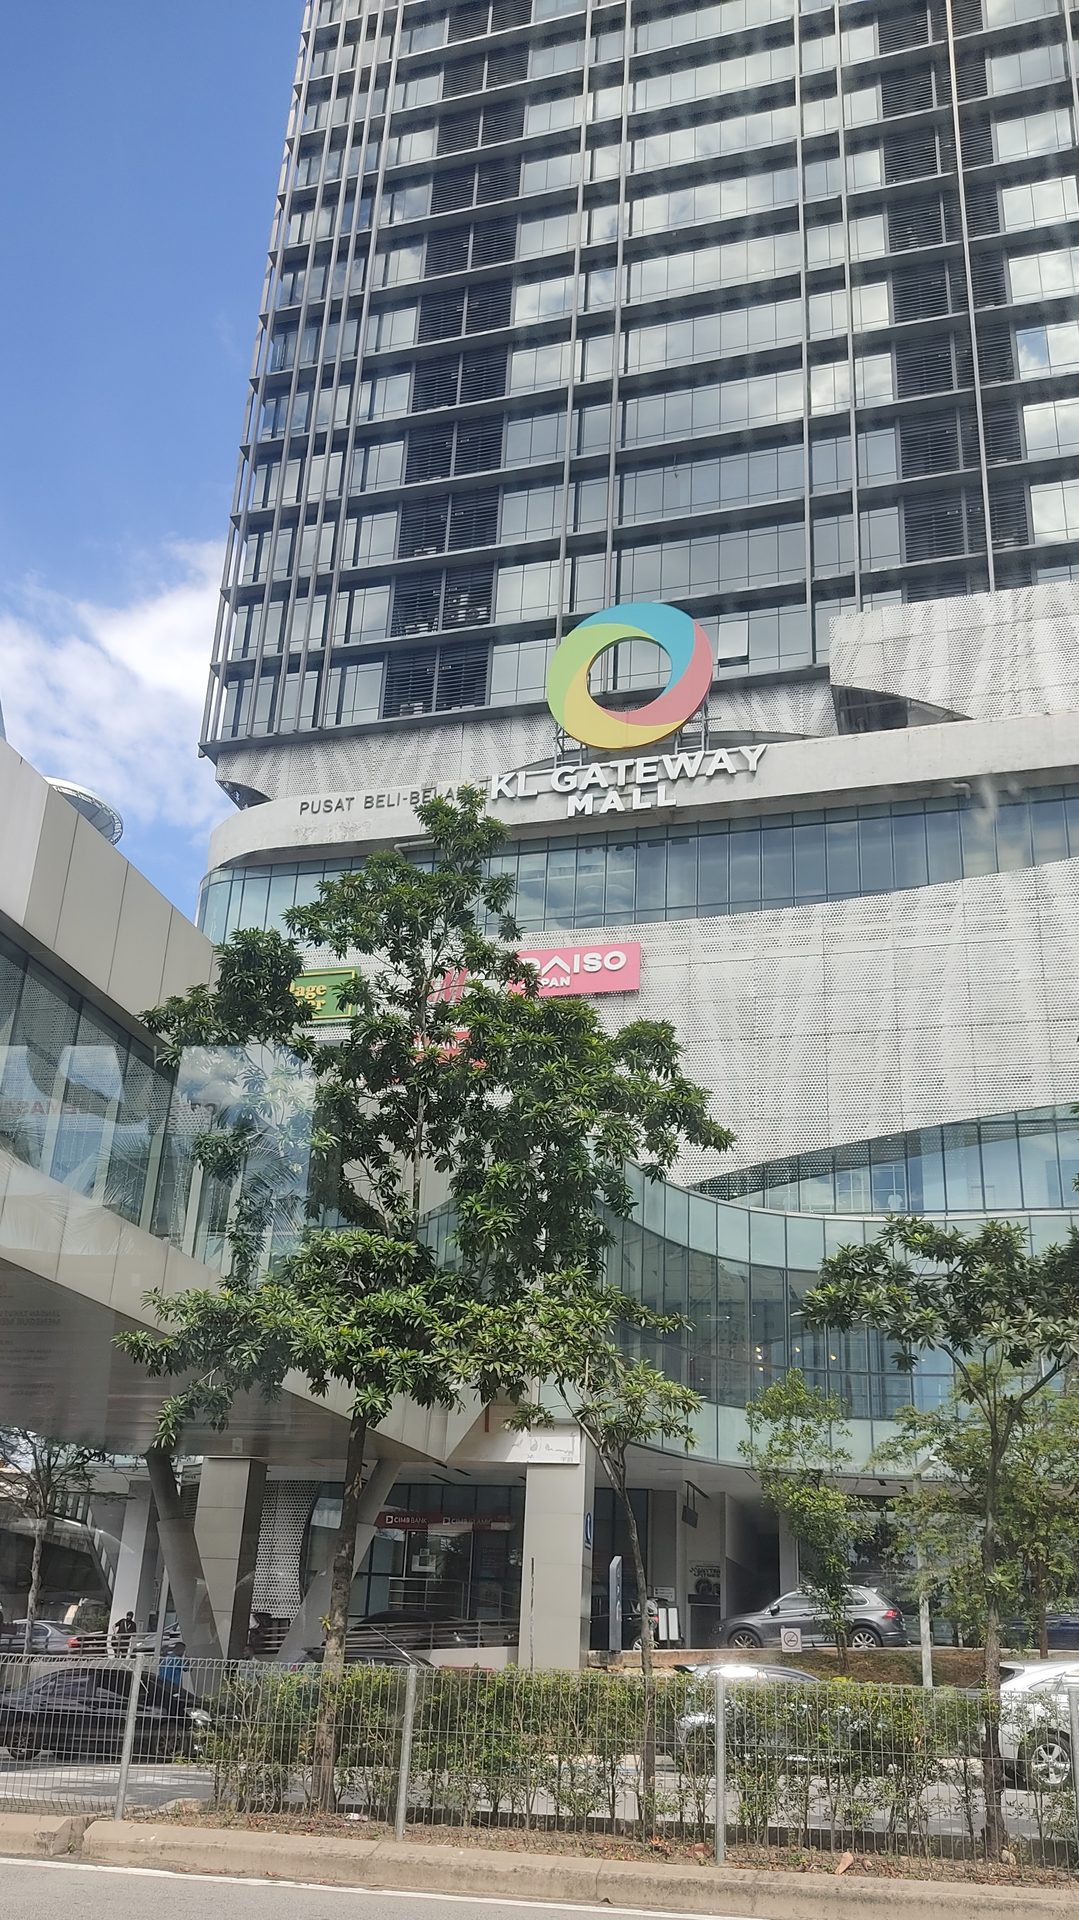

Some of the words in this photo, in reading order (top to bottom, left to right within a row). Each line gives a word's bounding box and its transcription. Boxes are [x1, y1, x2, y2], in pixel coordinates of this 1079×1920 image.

[490, 771, 538, 801] KL
[550, 744, 768, 793] GATEWAY
[299, 797, 355, 816] PUSAT
[363, 786, 467, 810] BELI-BEA
[567, 785, 677, 817] MALL
[394, 1516, 410, 1524] CIMB
[411, 1516, 427, 1524] BANK
